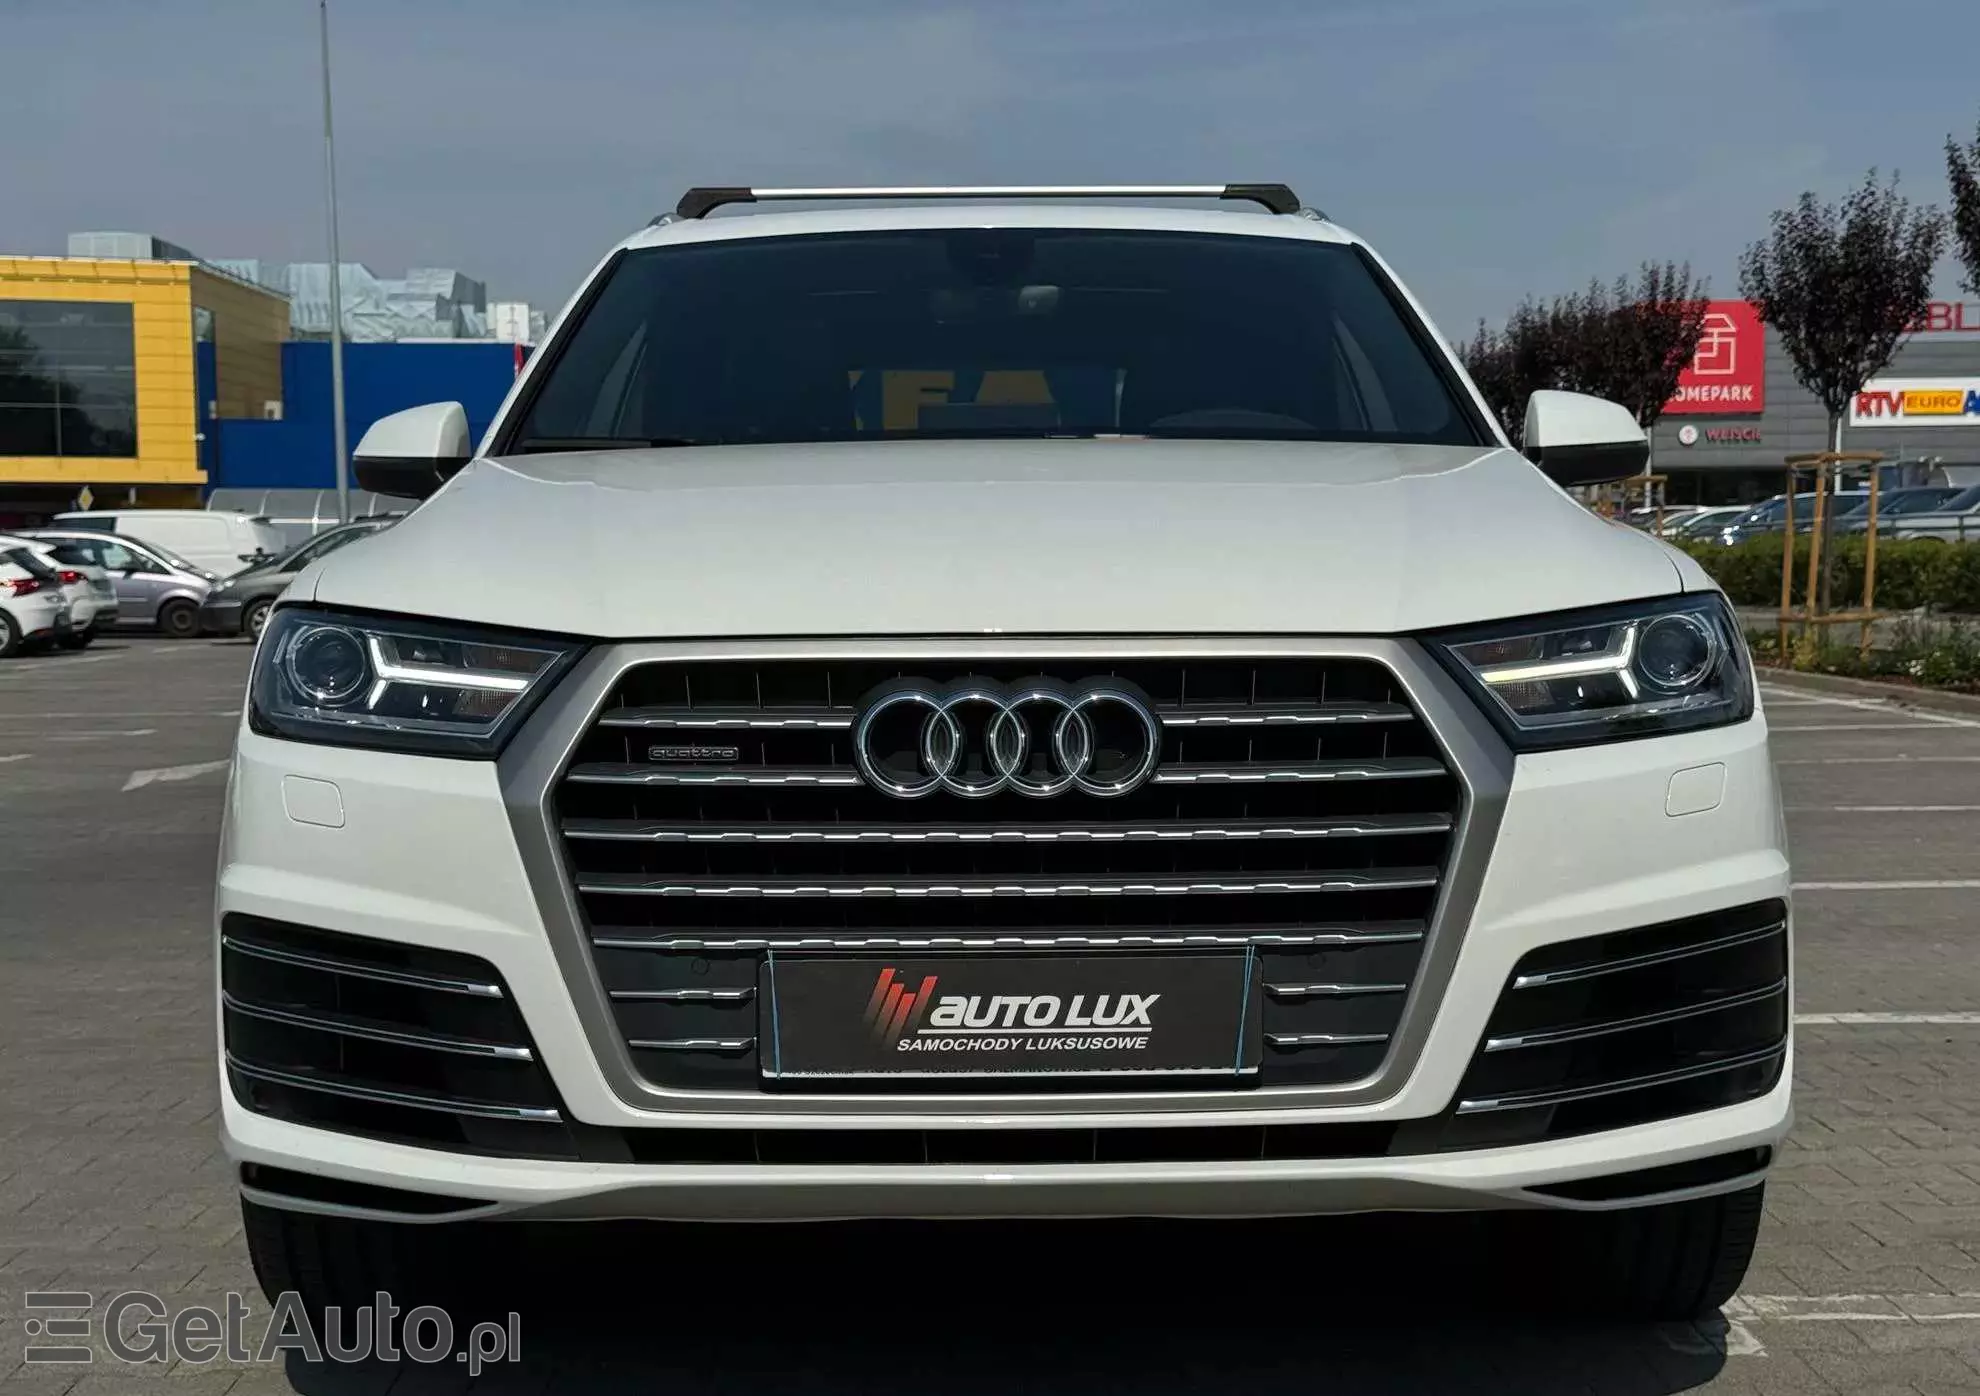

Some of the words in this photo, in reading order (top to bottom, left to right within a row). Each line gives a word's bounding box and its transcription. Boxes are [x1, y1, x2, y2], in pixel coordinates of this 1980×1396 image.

[1668, 385, 1753, 403] OMEPARK
[1855, 391, 1905, 417] RTV
[1906, 394, 1961, 410] EURO
[652, 747, 735, 759] quattro
[1064, 993, 1161, 1027] LUX
[896, 1037, 1023, 1052] SAMOCHODY
[1025, 1035, 1150, 1051] LUKSUSOWE
